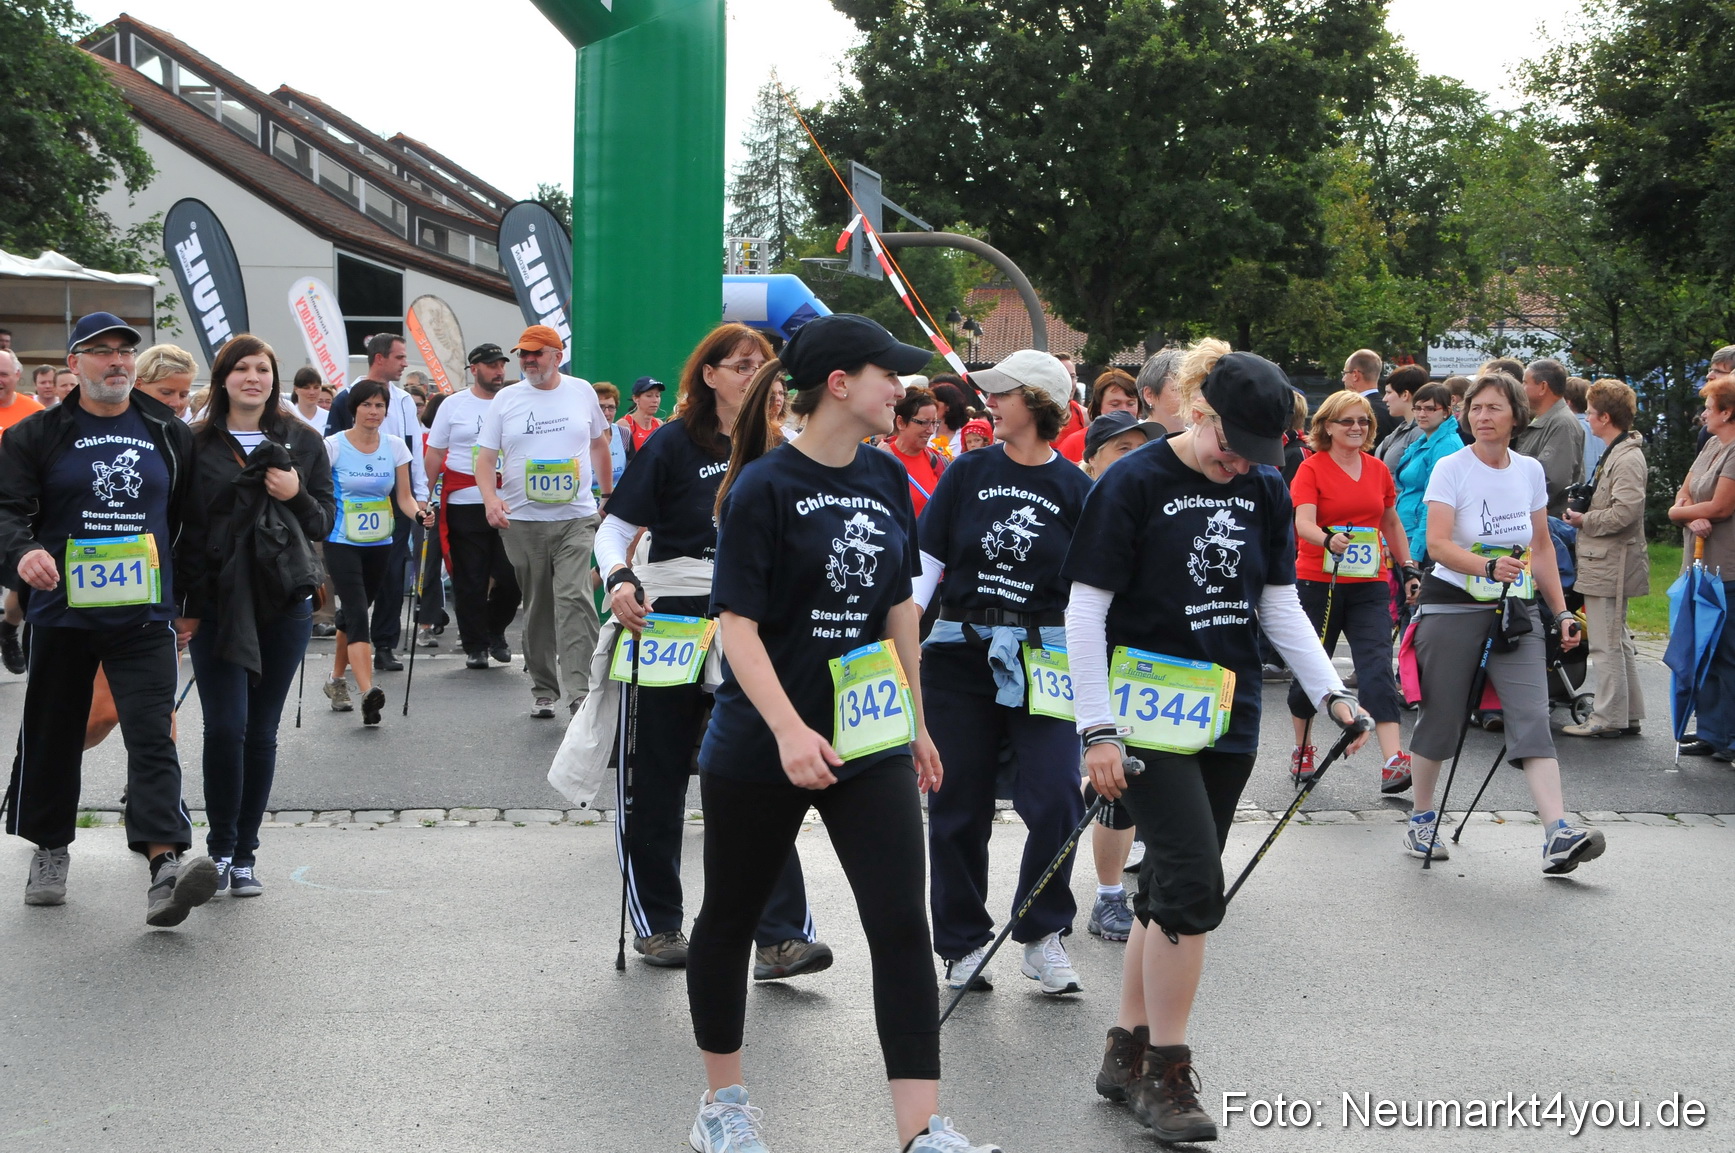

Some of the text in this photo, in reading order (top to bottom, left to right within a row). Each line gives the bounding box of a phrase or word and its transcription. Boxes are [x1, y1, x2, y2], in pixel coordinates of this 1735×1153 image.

[74, 434, 155, 451] Chickenrun
[529, 475, 573, 491] 1013
[978, 485, 1061, 515] Chickenrun
[1163, 494, 1255, 516] Chickenrun
[82, 510, 146, 520] Steuerkanzlei
[357, 512, 380, 531] 20
[1492, 511, 1526, 522] EVANGELISCH
[84, 522, 143, 532] Heinz Müller
[1495, 524, 1527, 535] NEUMARKT
[1344, 544, 1372, 565] 53
[72, 560, 143, 589] 1341
[996, 562, 1014, 572] der
[997, 587, 1027, 604] Müller
[1205, 584, 1224, 594] der
[1212, 614, 1249, 626] Müller
[623, 639, 695, 667] 1340
[1127, 667, 1167, 681] firmenlauf
[1033, 668, 1075, 701] 133
[839, 680, 903, 731] 1342
[1113, 682, 1211, 729] 1344
